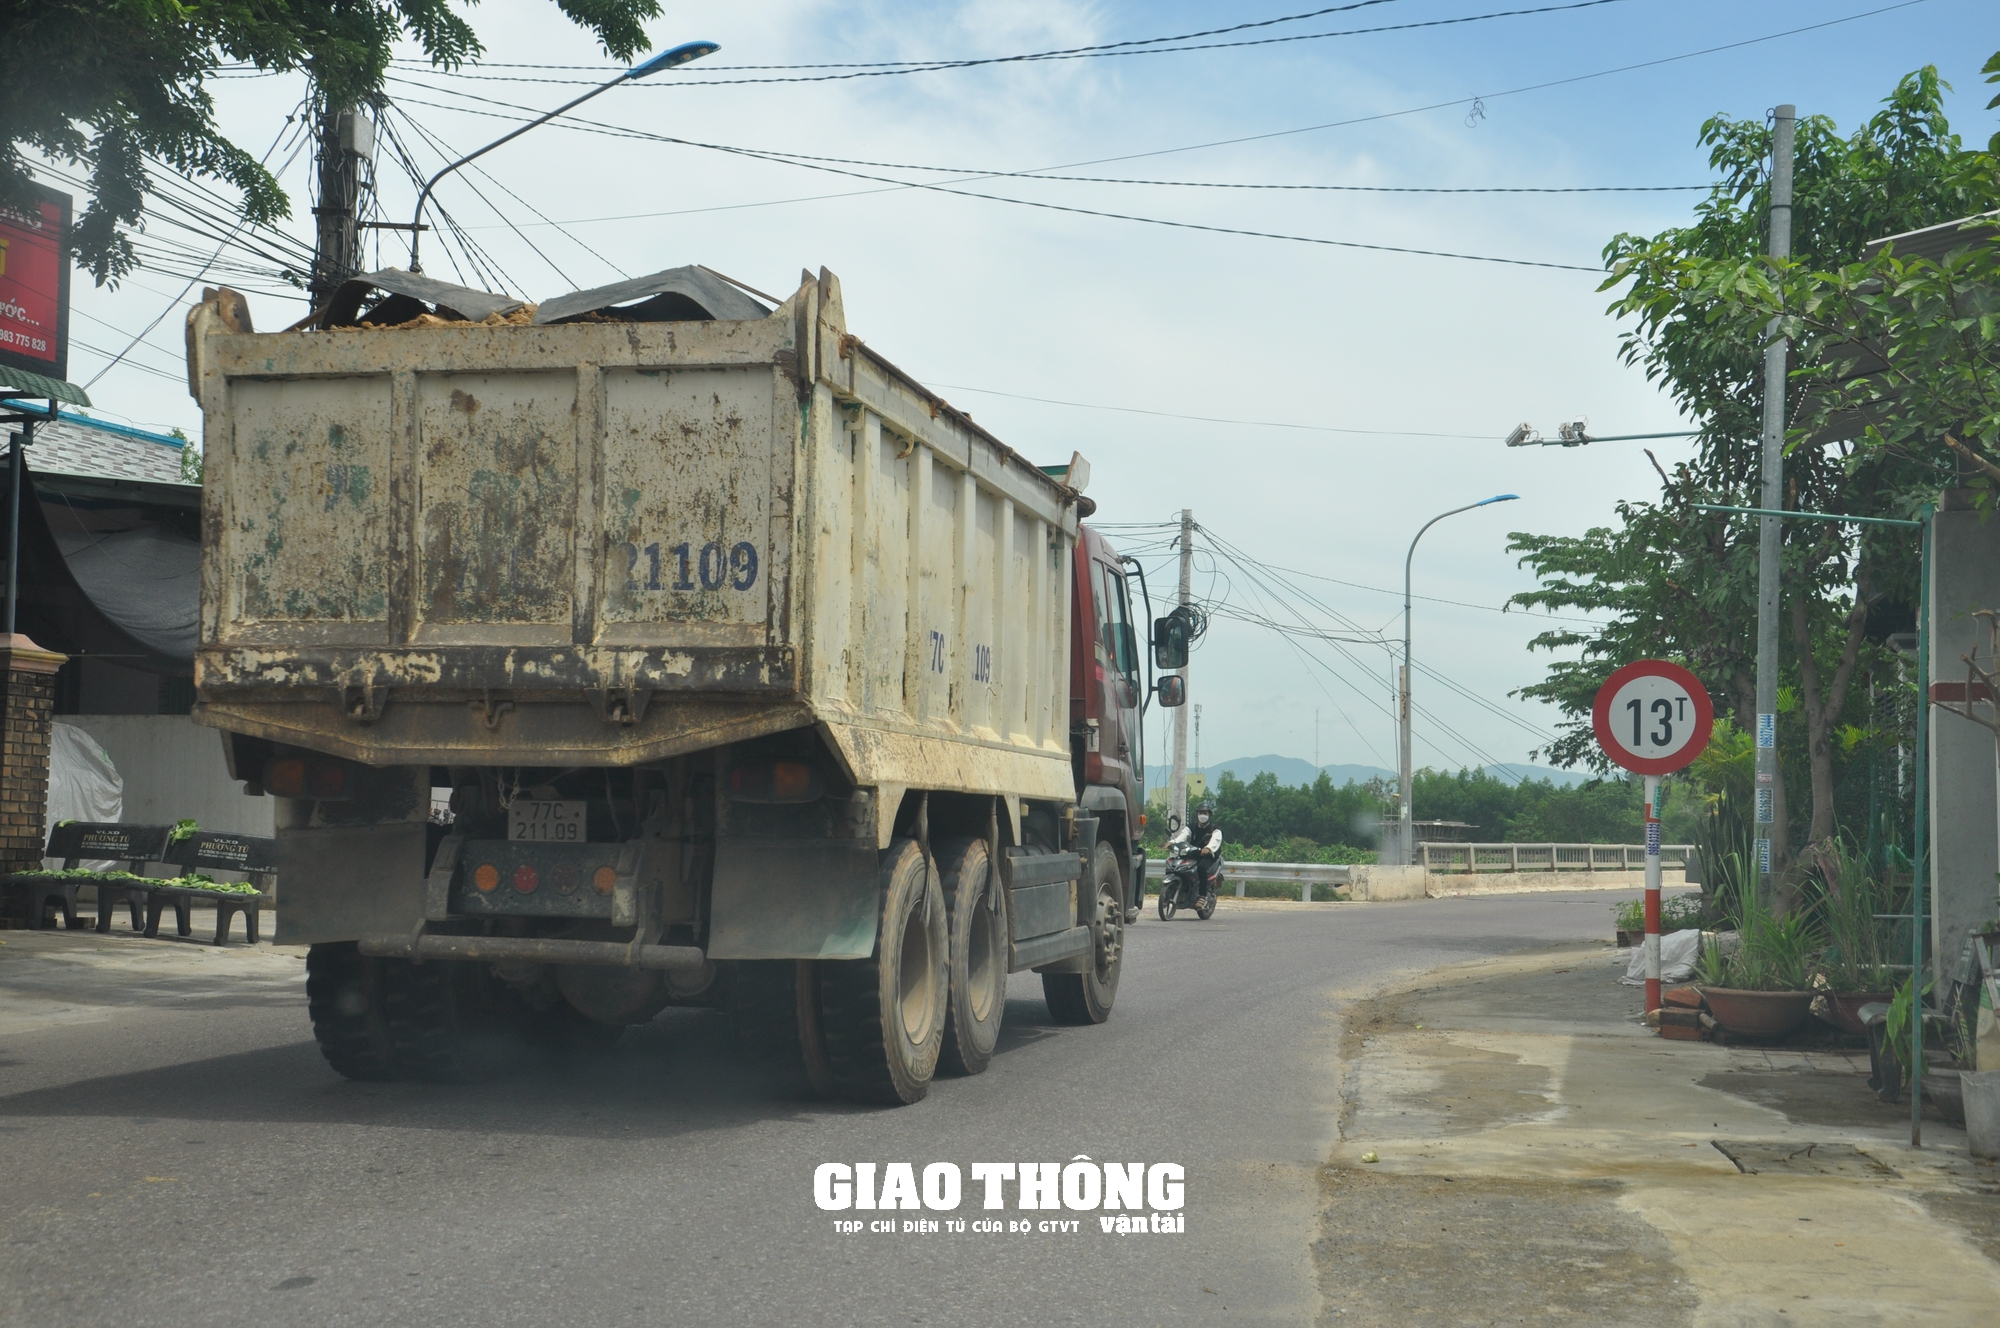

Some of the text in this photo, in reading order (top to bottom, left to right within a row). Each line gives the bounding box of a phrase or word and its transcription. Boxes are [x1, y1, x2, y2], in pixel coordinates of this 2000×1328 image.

[15, 333, 30, 348] 775
[31, 337, 46, 352] 828
[531, 802, 564, 820] 77C
[516, 822, 577, 840] 211.09
